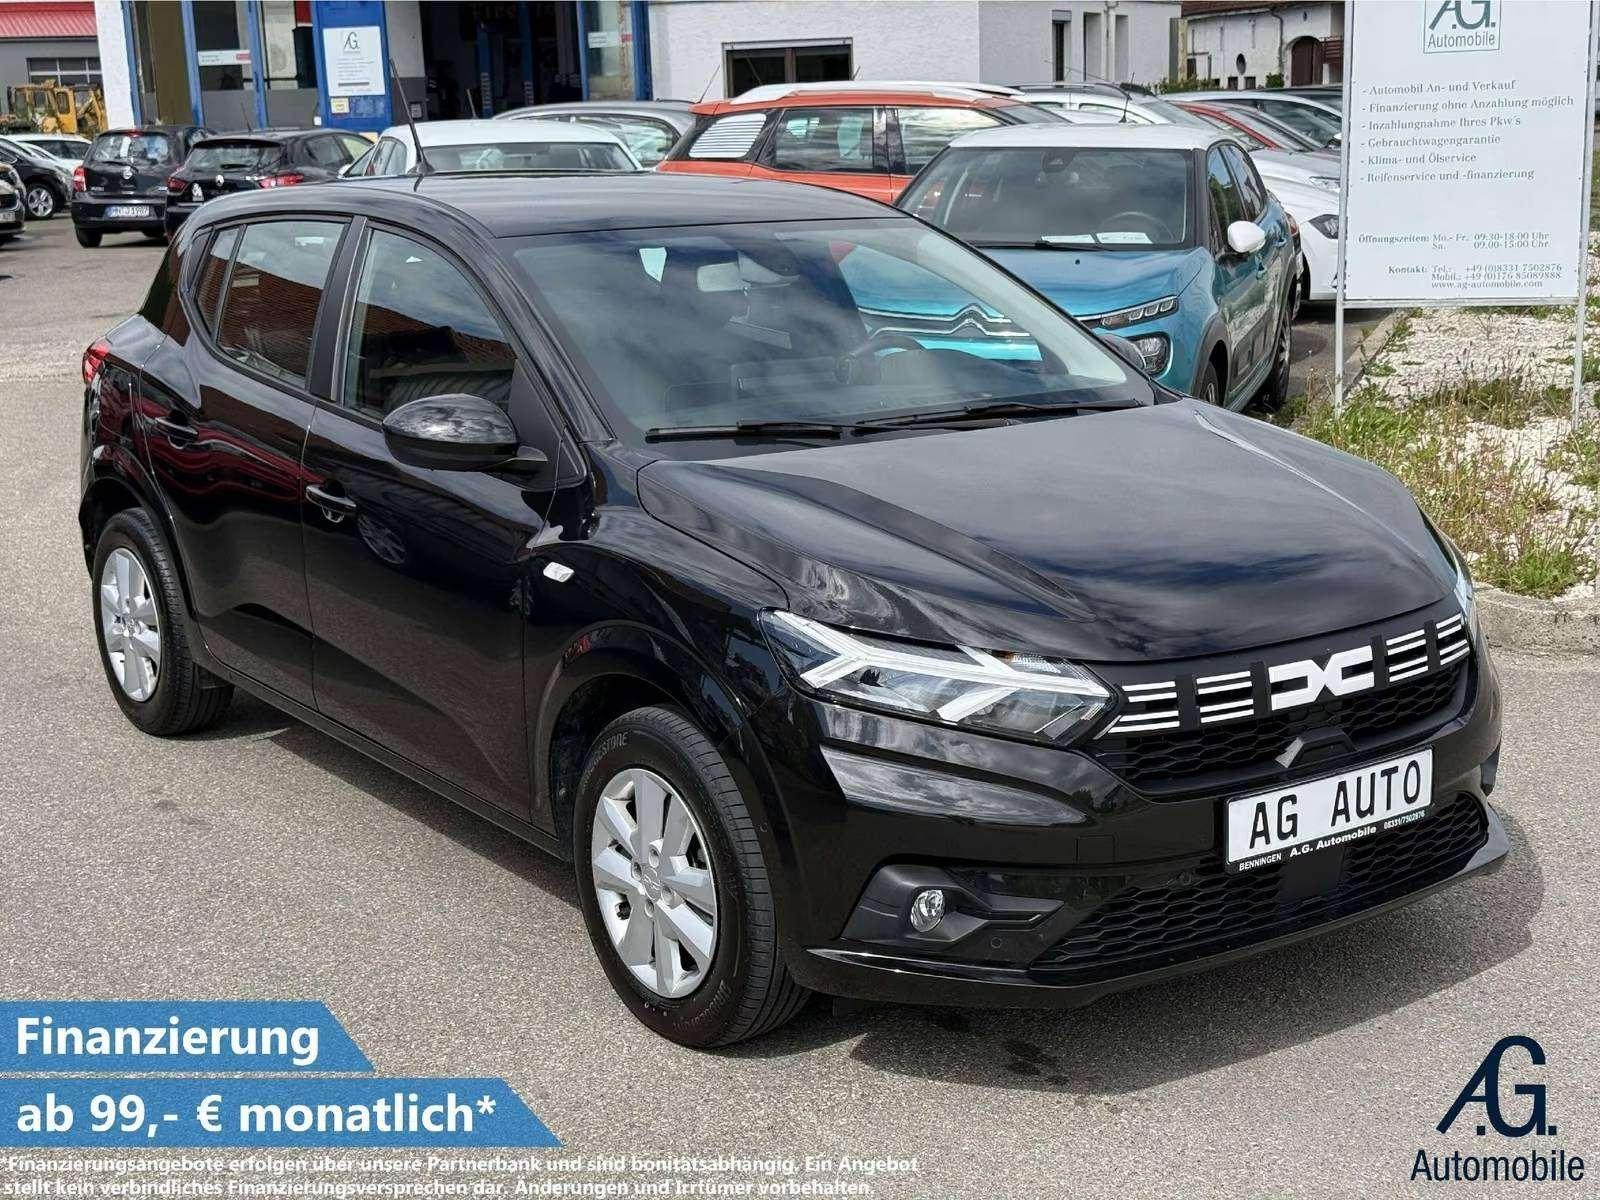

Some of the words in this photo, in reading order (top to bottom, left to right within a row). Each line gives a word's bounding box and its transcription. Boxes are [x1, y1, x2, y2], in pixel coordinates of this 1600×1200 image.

[1428, 31, 1495, 49] Automobile
[1369, 83, 1423, 96] Automobil
[1426, 83, 1446, 93] An-
[1448, 82, 1468, 92] und
[1472, 79, 1517, 92] Verkauf
[1369, 101, 1440, 113] Finanzierung
[1441, 100, 1467, 110] ohne
[1470, 98, 1529, 110] Anzahlung
[1531, 96, 1575, 109] möglich
[1368, 117, 1457, 131] Inzahlungnahme
[1459, 117, 1487, 127] Ihres
[1367, 134, 1501, 148] Gebrauchtwagengarantie
[1367, 154, 1402, 165] Klima-
[1405, 154, 1425, 164] und
[1427, 152, 1477, 164] Ölservice
[1367, 171, 1436, 183] Reifenservice
[1439, 170, 1459, 181] und
[1358, 233, 1430, 245] Öffnungszeiten:
[1531, 231, 1550, 240] Uhr
[1531, 240, 1550, 249] Uhr
[1431, 280, 1543, 290] www.ag-automobile.com
[1249, 794, 1298, 850] AG
[1330, 759, 1421, 827] AUTO
[1239, 852, 1282, 872] BENNINGEN
[1289, 842, 1314, 859] A.G.
[1316, 825, 1377, 851] Automobile
